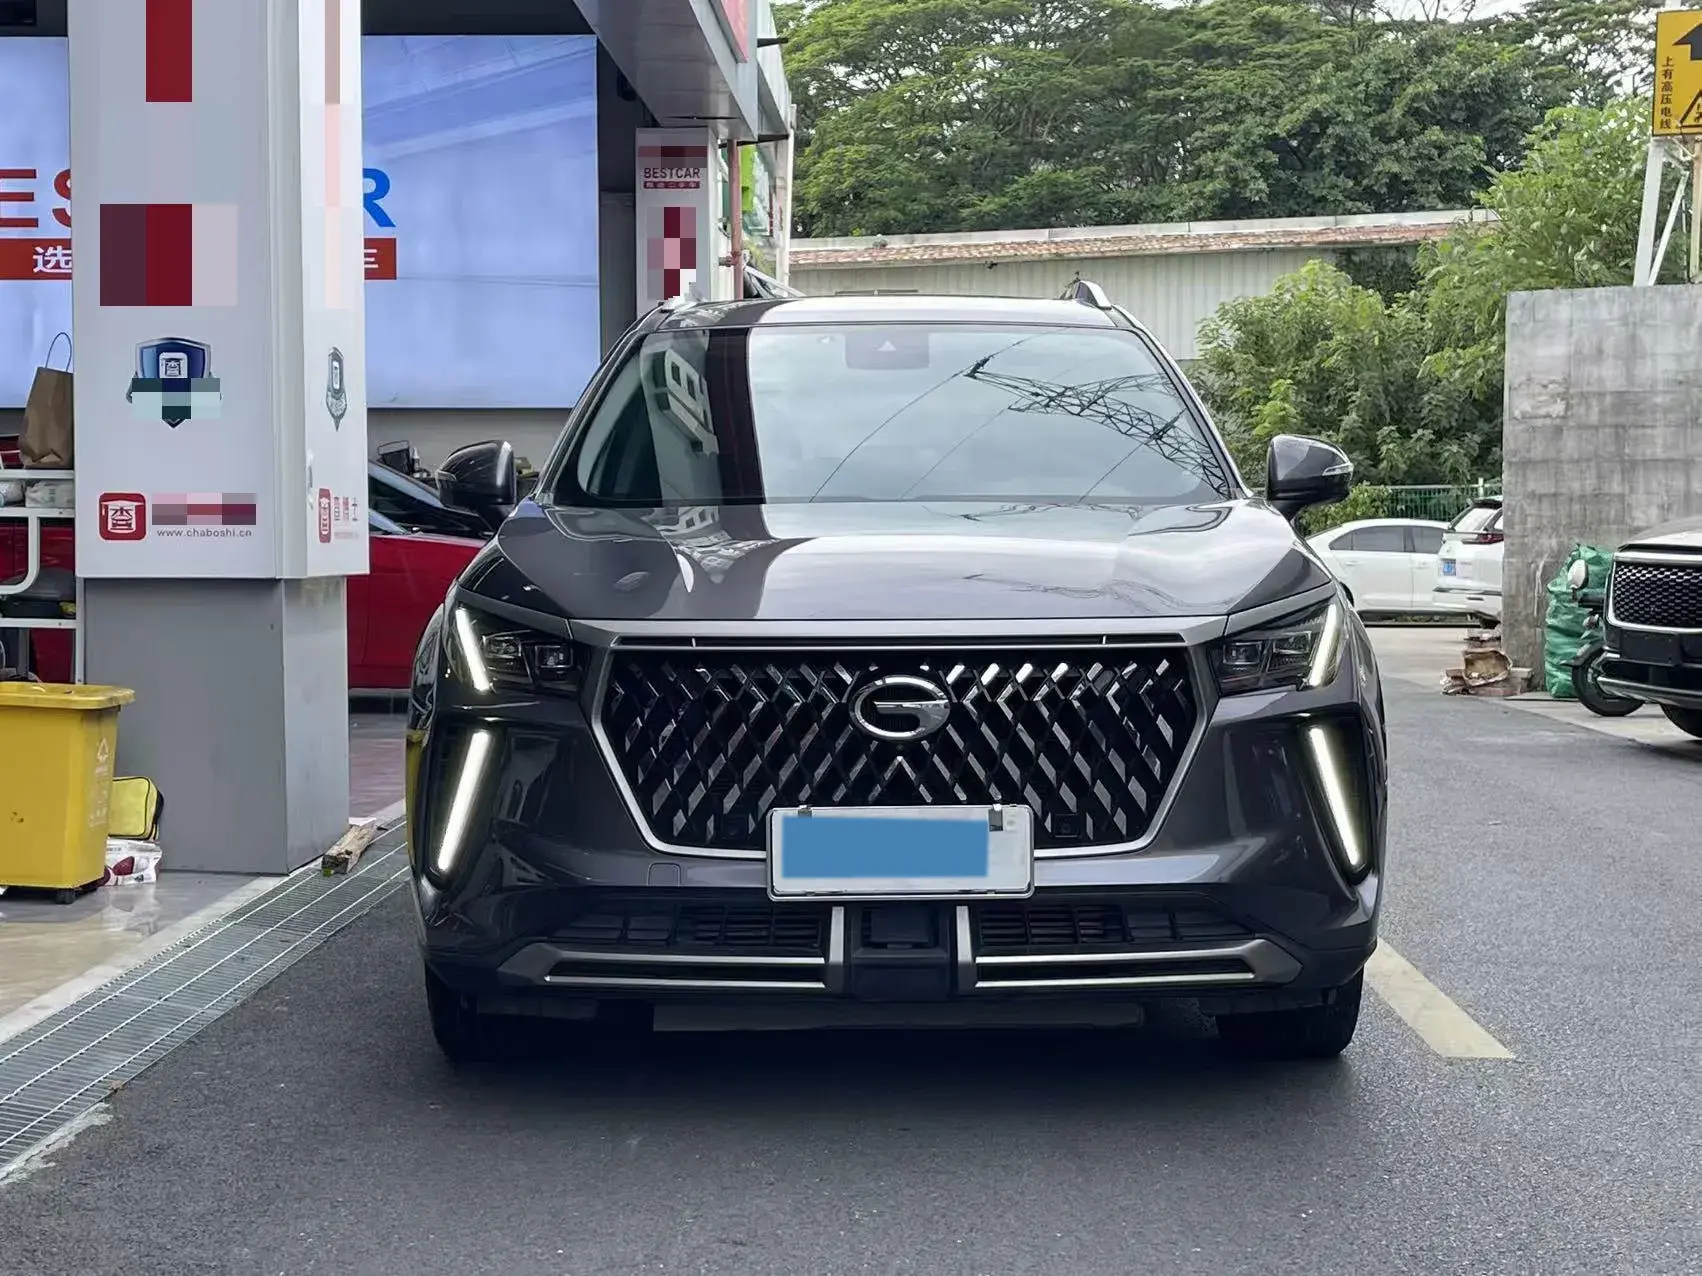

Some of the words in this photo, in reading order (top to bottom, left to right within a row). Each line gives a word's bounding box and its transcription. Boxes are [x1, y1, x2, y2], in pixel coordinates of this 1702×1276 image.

[1660, 56, 1674, 129] 上有高压电线
[643, 167, 700, 178] BESTCAR
[157, 528, 252, 537] www.chaboshi.cn
